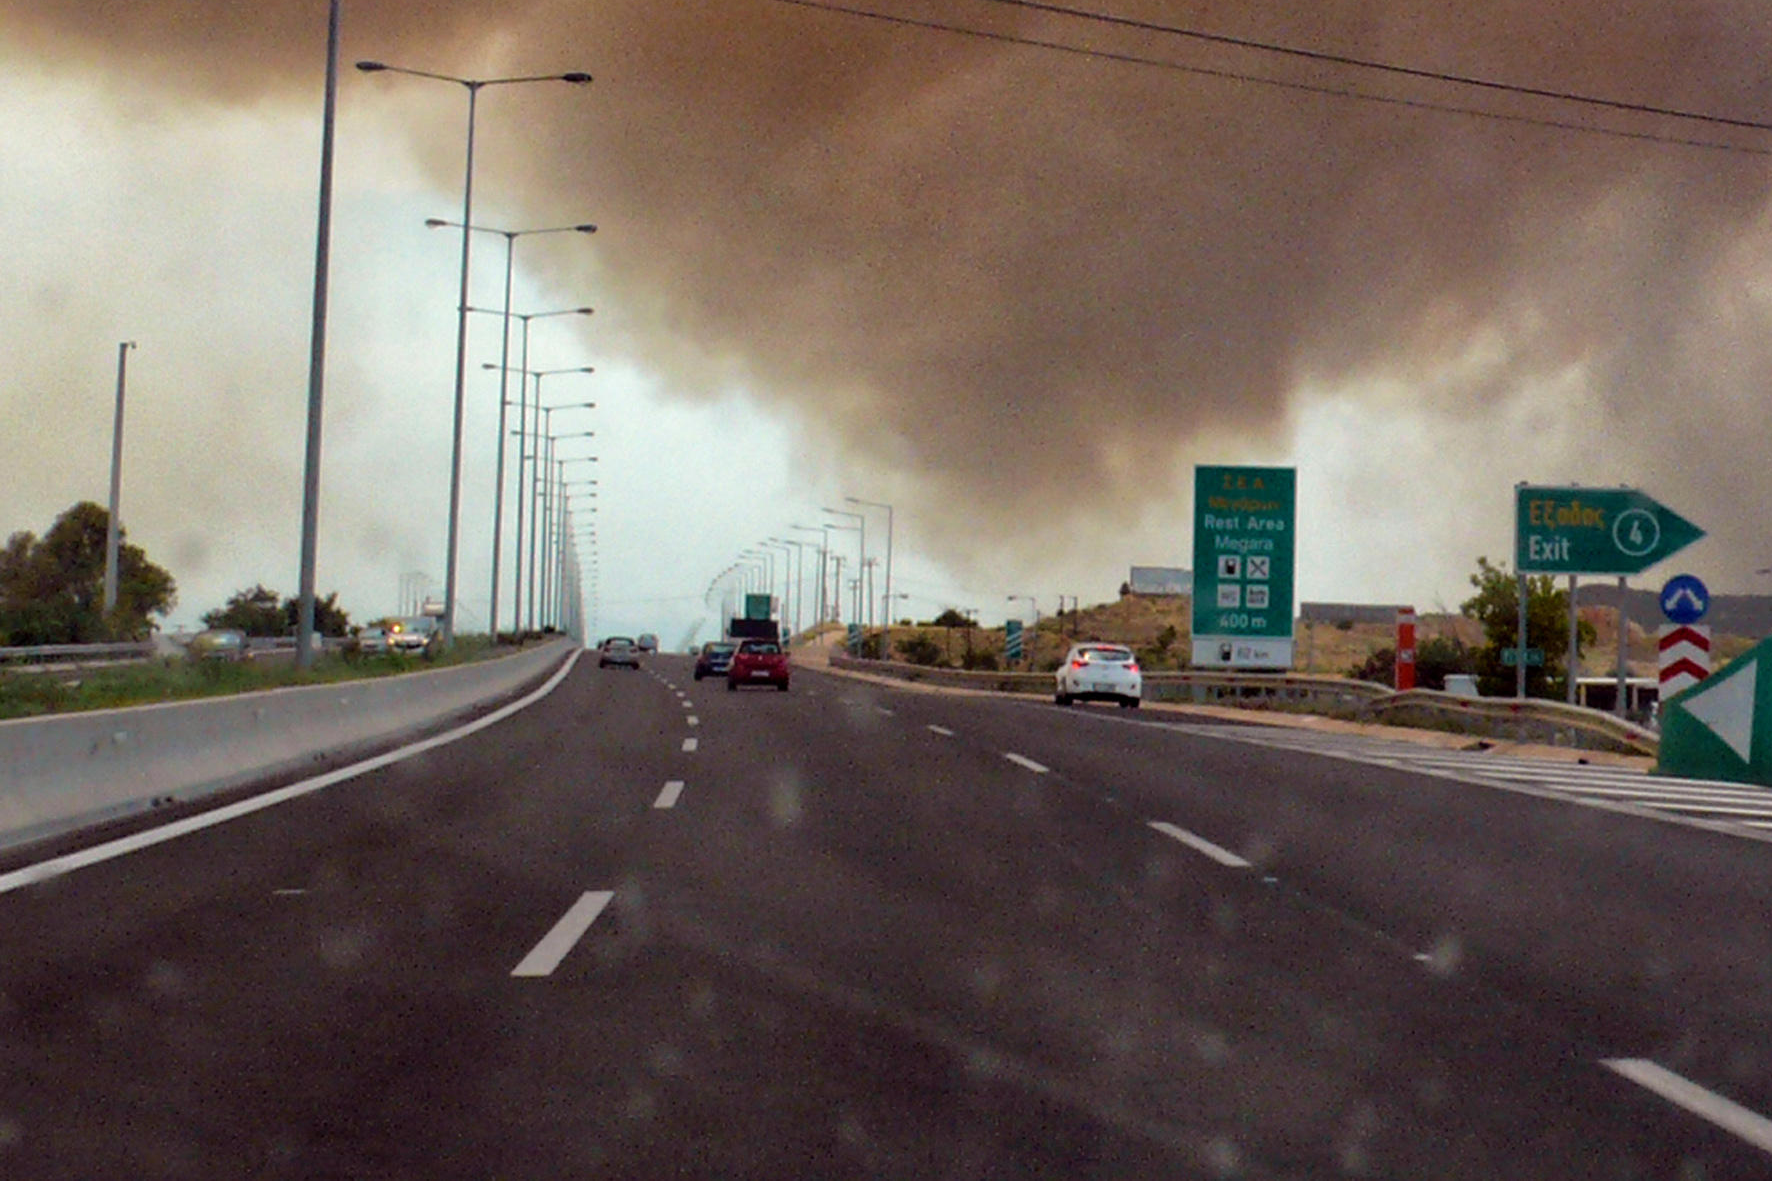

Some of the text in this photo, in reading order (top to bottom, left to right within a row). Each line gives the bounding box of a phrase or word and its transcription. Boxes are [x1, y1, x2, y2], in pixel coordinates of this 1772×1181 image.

[1204, 514, 1285, 531] Rest Area
[1629, 520, 1643, 545] 4
[1215, 535, 1274, 554] Megara
[1529, 535, 1570, 561] Exit
[1220, 613, 1267, 628] 400 m
